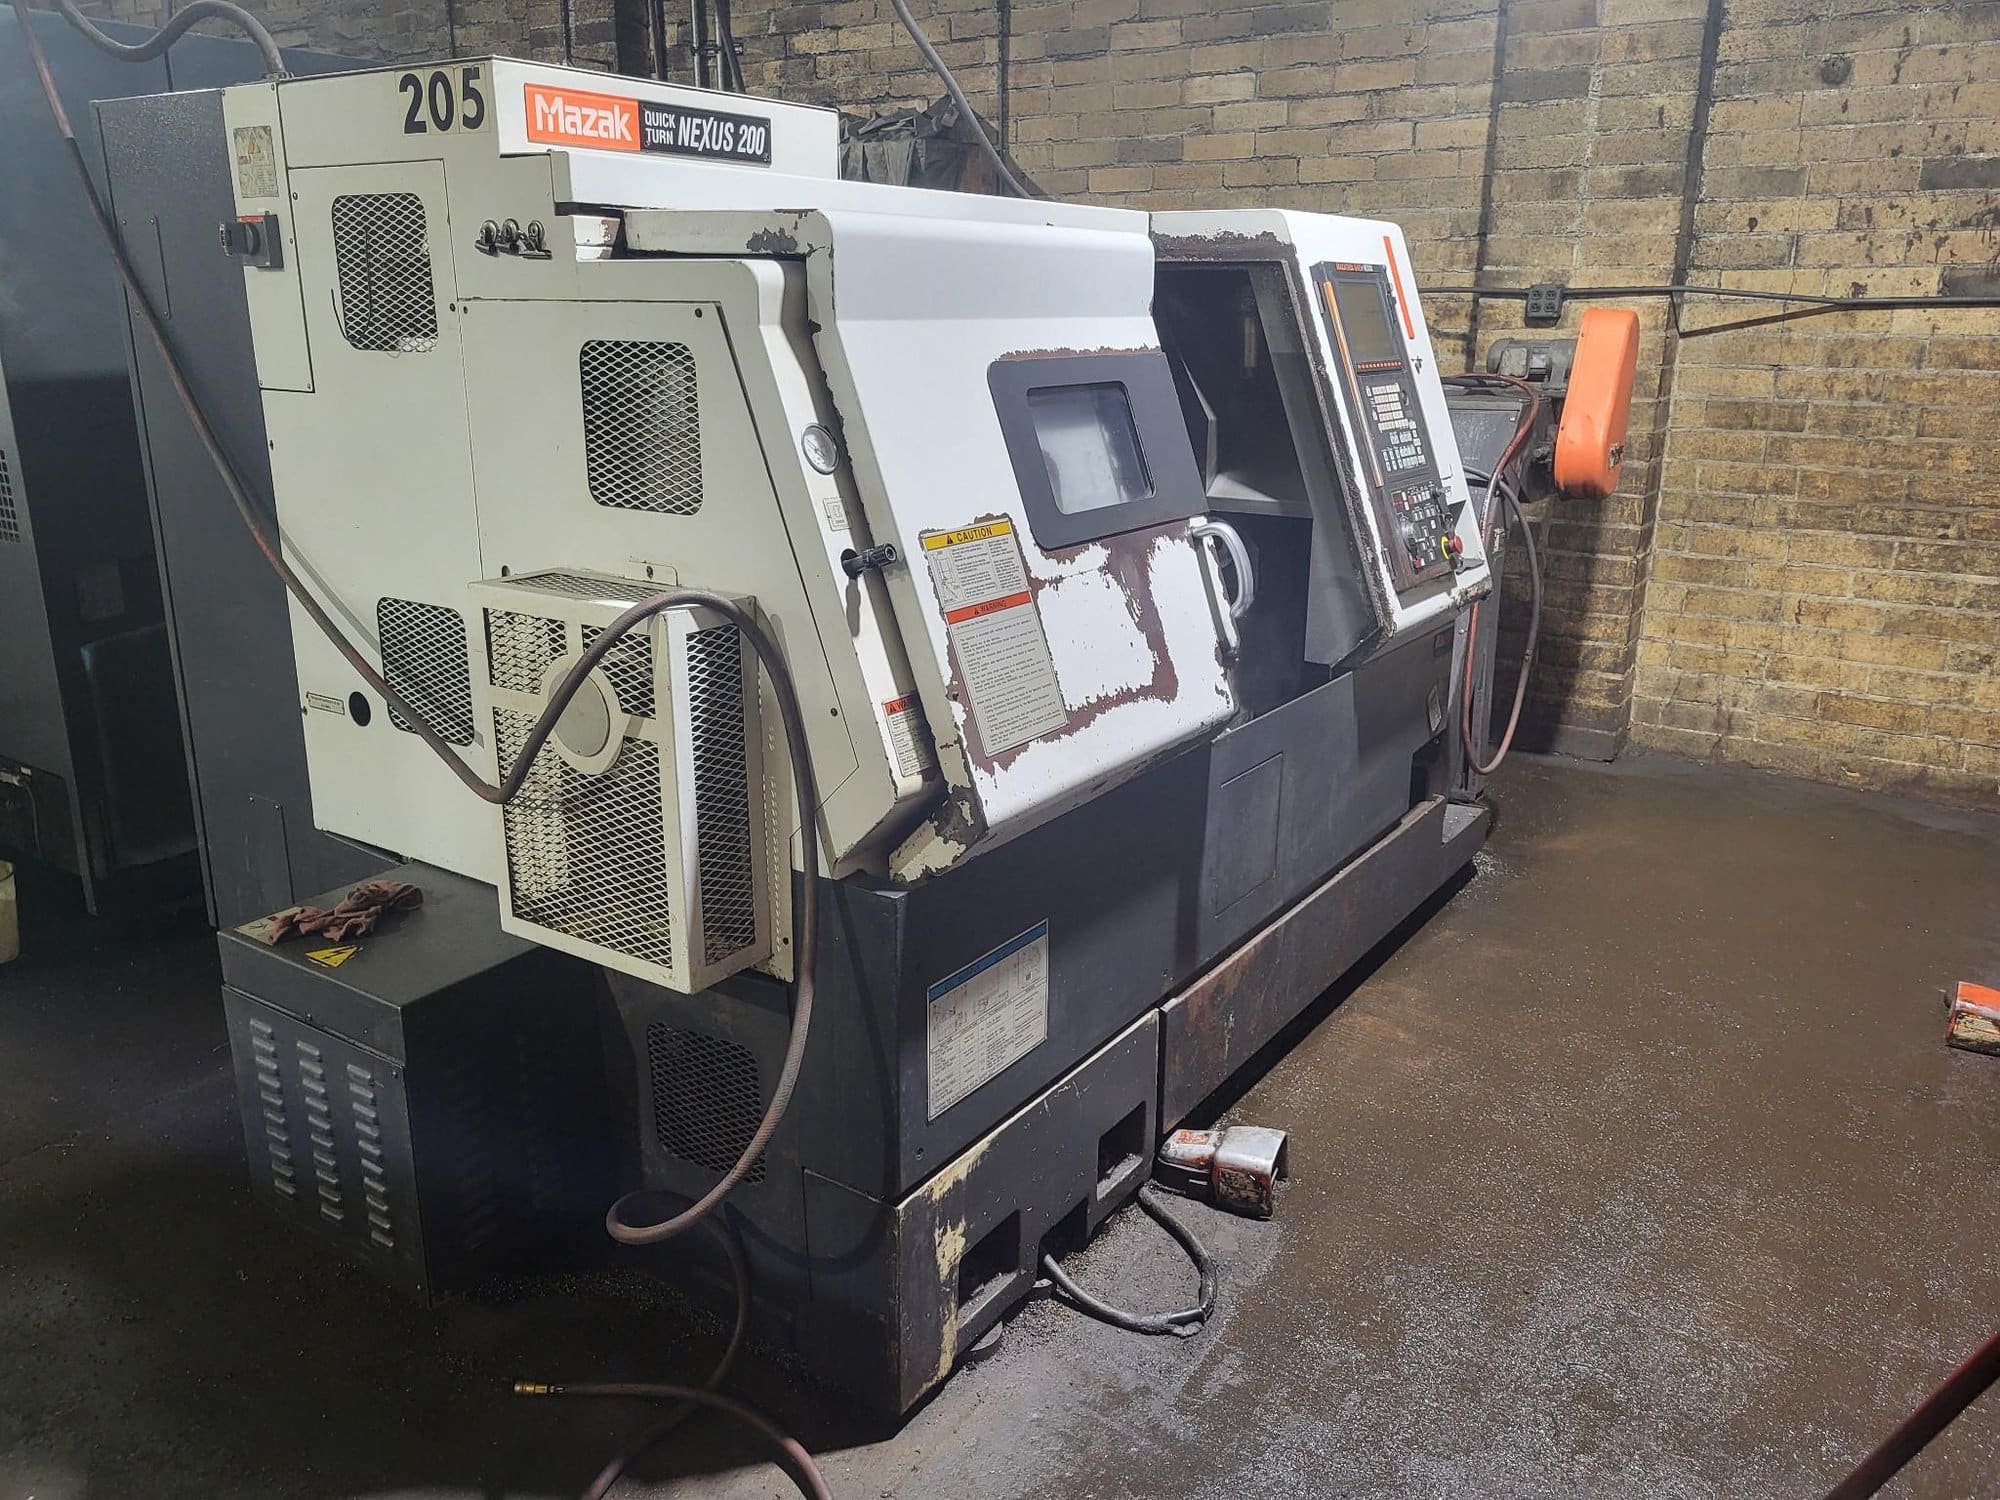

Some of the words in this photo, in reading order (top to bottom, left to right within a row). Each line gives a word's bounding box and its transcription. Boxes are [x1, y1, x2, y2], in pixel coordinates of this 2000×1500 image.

[399, 67, 484, 134] 205
[534, 93, 632, 141] Mazak
[644, 110, 676, 129] QUICK
[645, 127, 673, 145] TURN
[678, 116, 734, 152] NEXUS
[737, 124, 765, 155] 200
[956, 527, 992, 542] CAUTION
